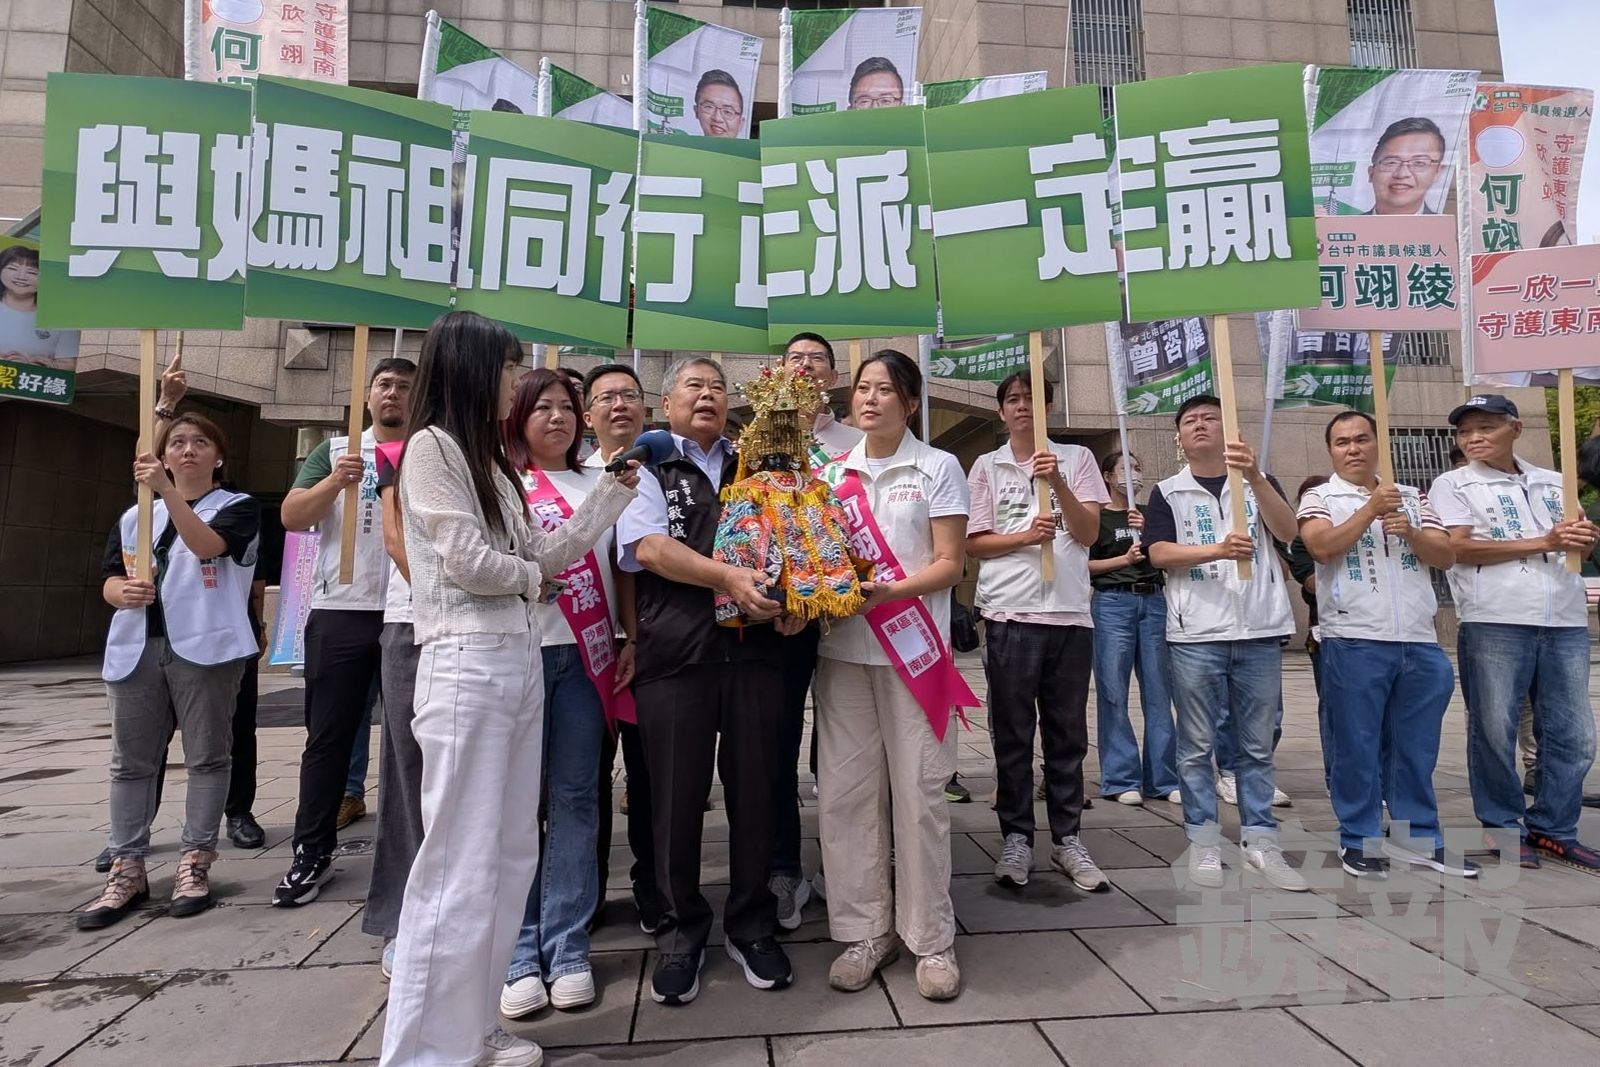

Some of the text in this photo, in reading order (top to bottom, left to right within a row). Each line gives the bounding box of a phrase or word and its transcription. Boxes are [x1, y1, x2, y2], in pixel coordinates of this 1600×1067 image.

[312, 2, 338, 77] 守護東南
[1328, 244, 1447, 257] 台中市議員候選人
[1487, 273, 1600, 302] 一欣一
[665, 489, 687, 538] 何敏誠
[1498, 495, 1523, 533] 何翊綾
[885, 614, 912, 637] 東區
[908, 652, 934, 674] 南區
